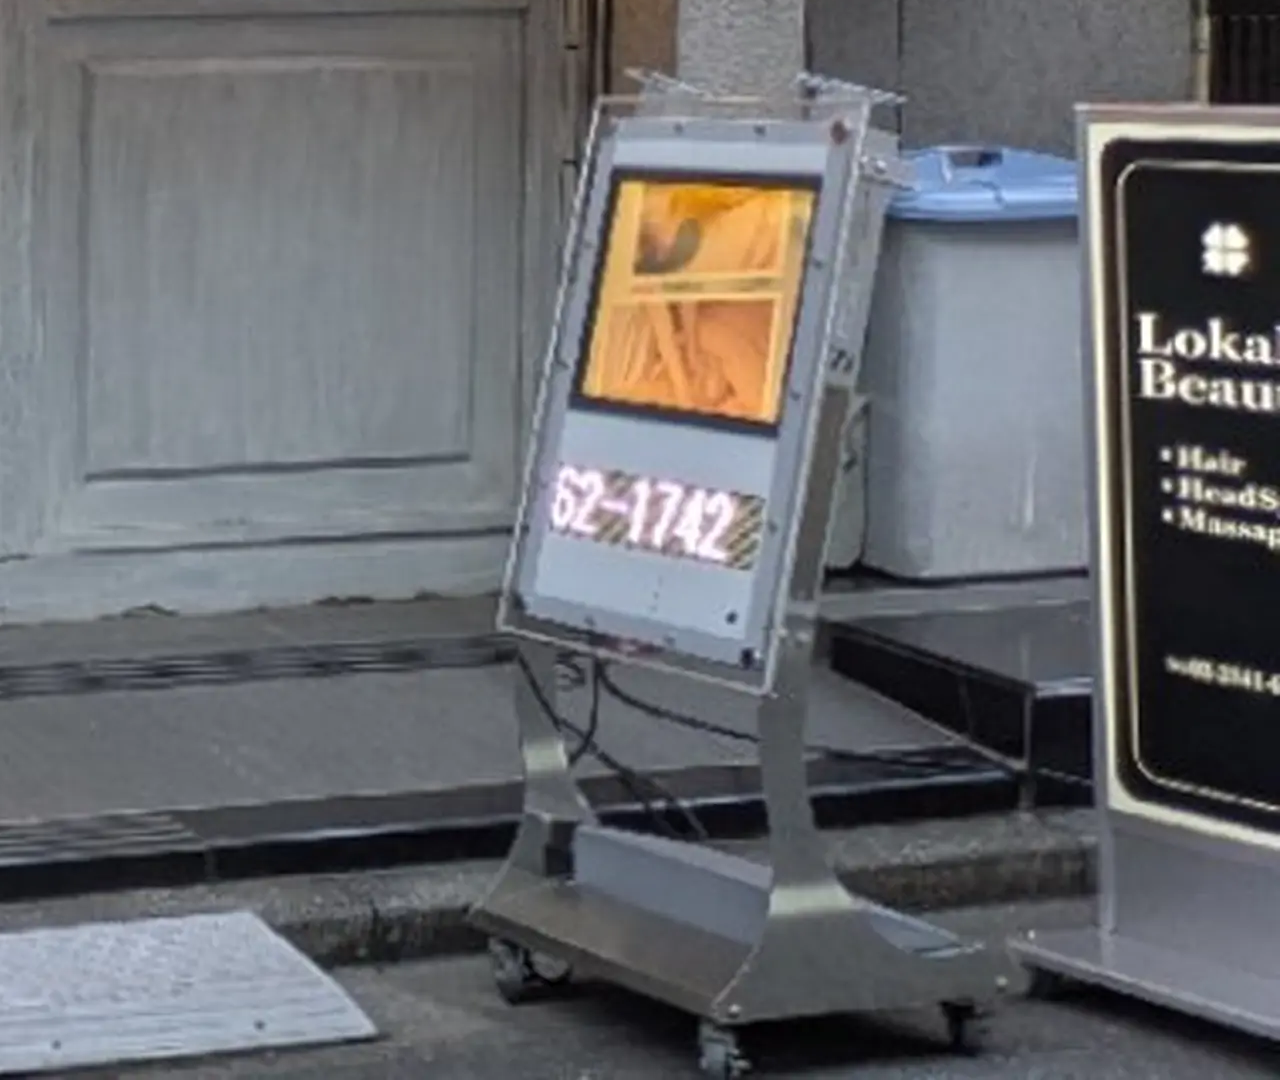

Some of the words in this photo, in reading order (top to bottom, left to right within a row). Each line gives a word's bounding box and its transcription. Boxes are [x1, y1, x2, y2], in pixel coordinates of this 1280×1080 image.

[1136, 311, 1280, 366] Loka
[1139, 358, 1280, 412] Beau
[1177, 444, 1247, 476] Hair
[1178, 475, 1280, 512] HeadS
